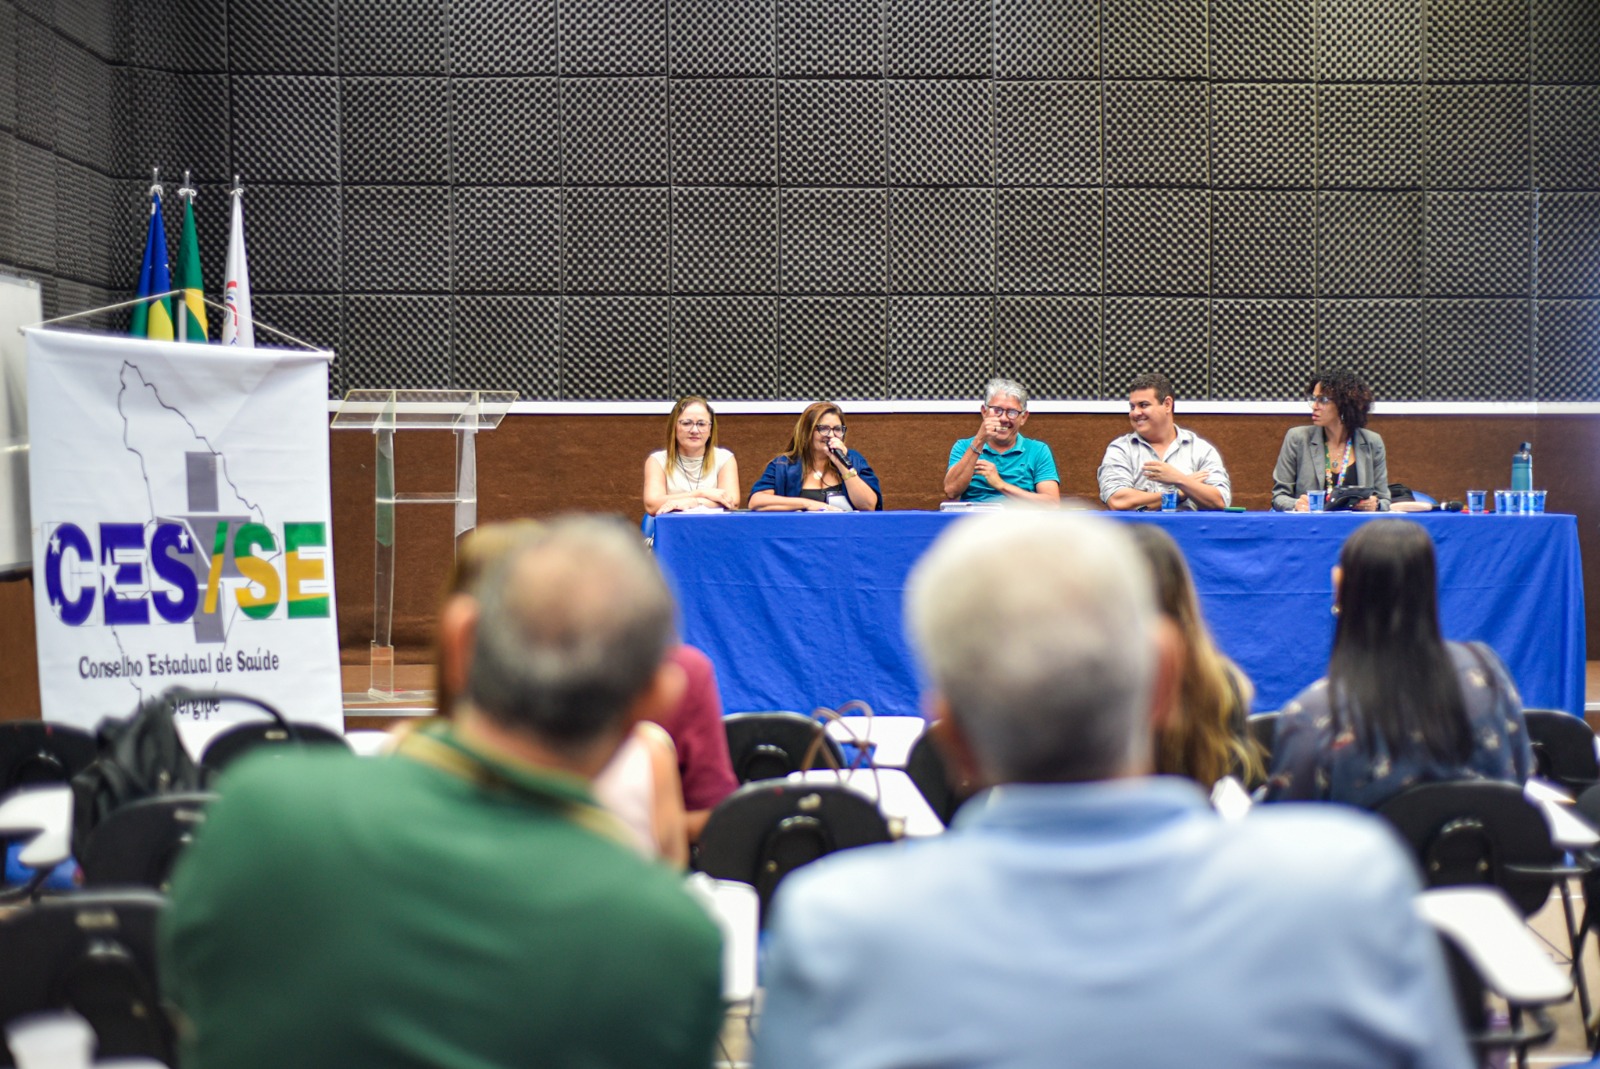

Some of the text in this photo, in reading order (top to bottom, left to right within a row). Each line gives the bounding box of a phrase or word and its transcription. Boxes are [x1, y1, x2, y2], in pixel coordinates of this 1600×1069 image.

[45, 521, 331, 627] CES/SE
[78, 647, 280, 679] Conselho Estadual de Saúde
